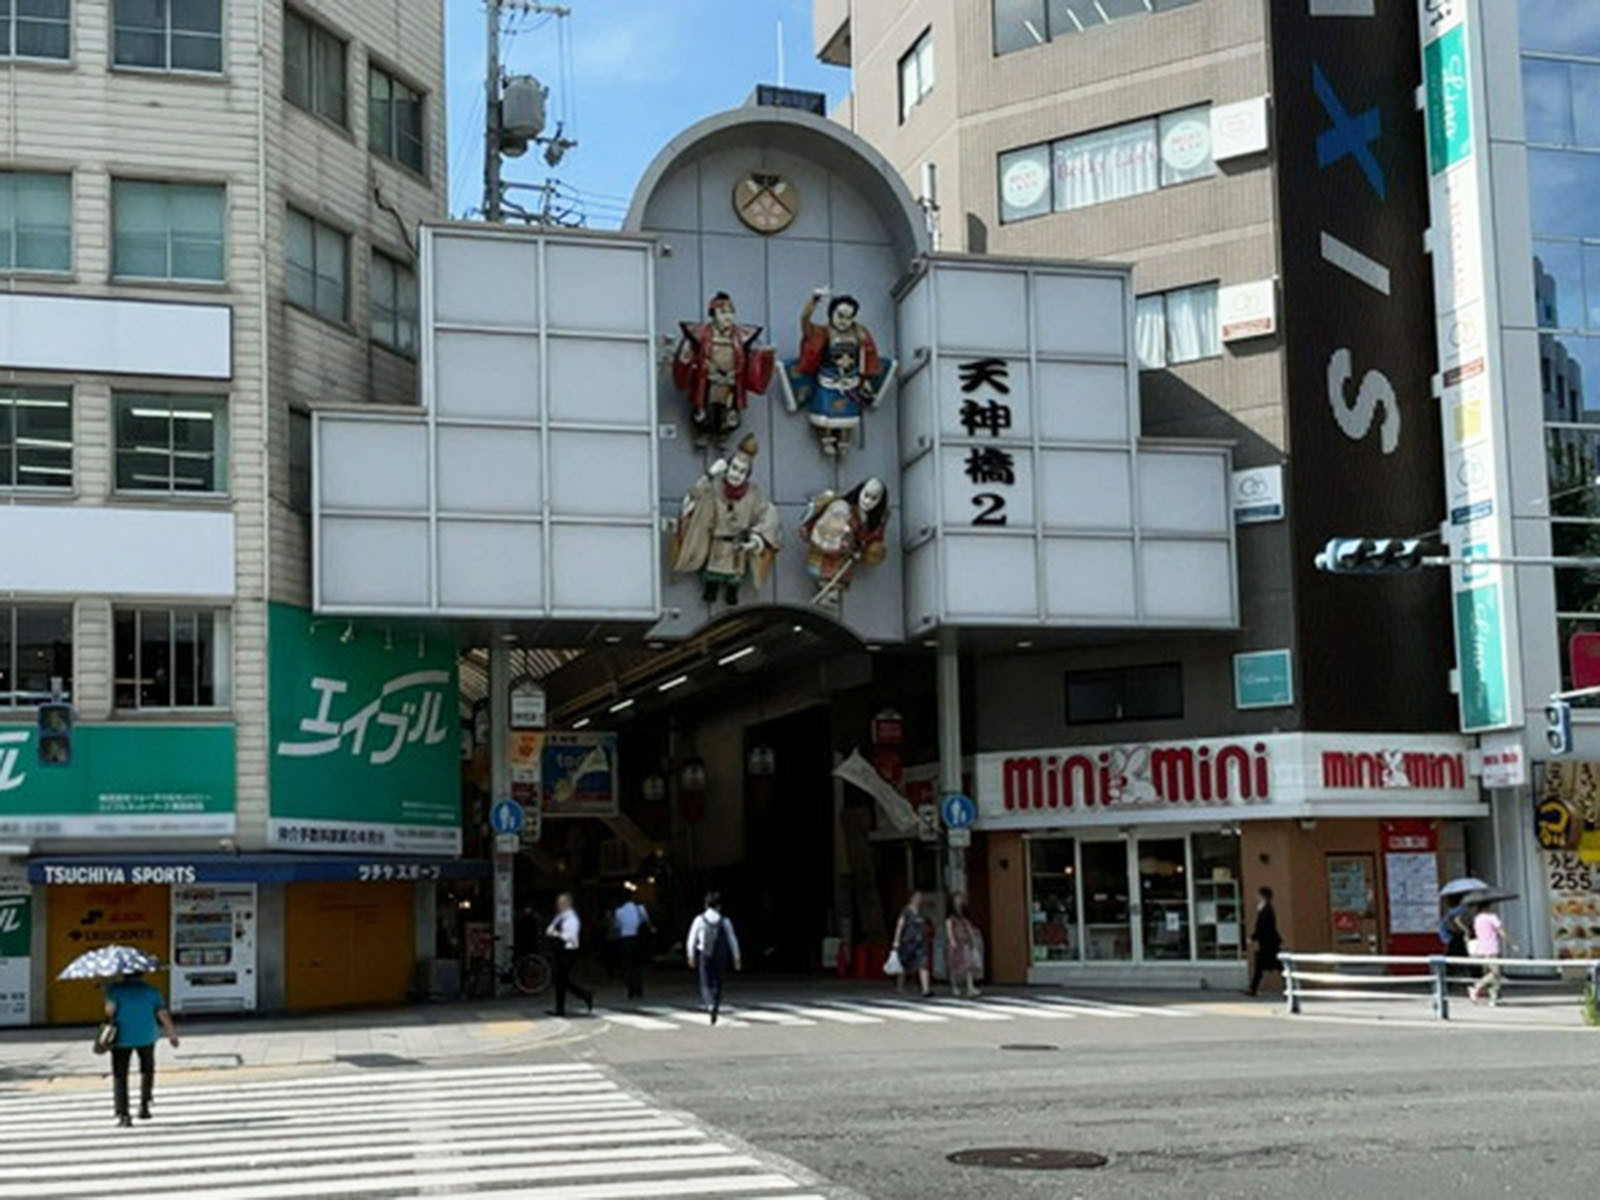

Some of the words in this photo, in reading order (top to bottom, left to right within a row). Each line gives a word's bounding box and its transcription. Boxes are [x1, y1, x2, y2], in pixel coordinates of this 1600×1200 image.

[956, 357, 1015, 526] 天神橋2
[277, 669, 449, 764] エイブル
[1151, 742, 1269, 802] mini
[44, 865, 125, 884] TSUCHIYA
[132, 865, 196, 884] SPORTS
[1551, 872, 1593, 891] 255
